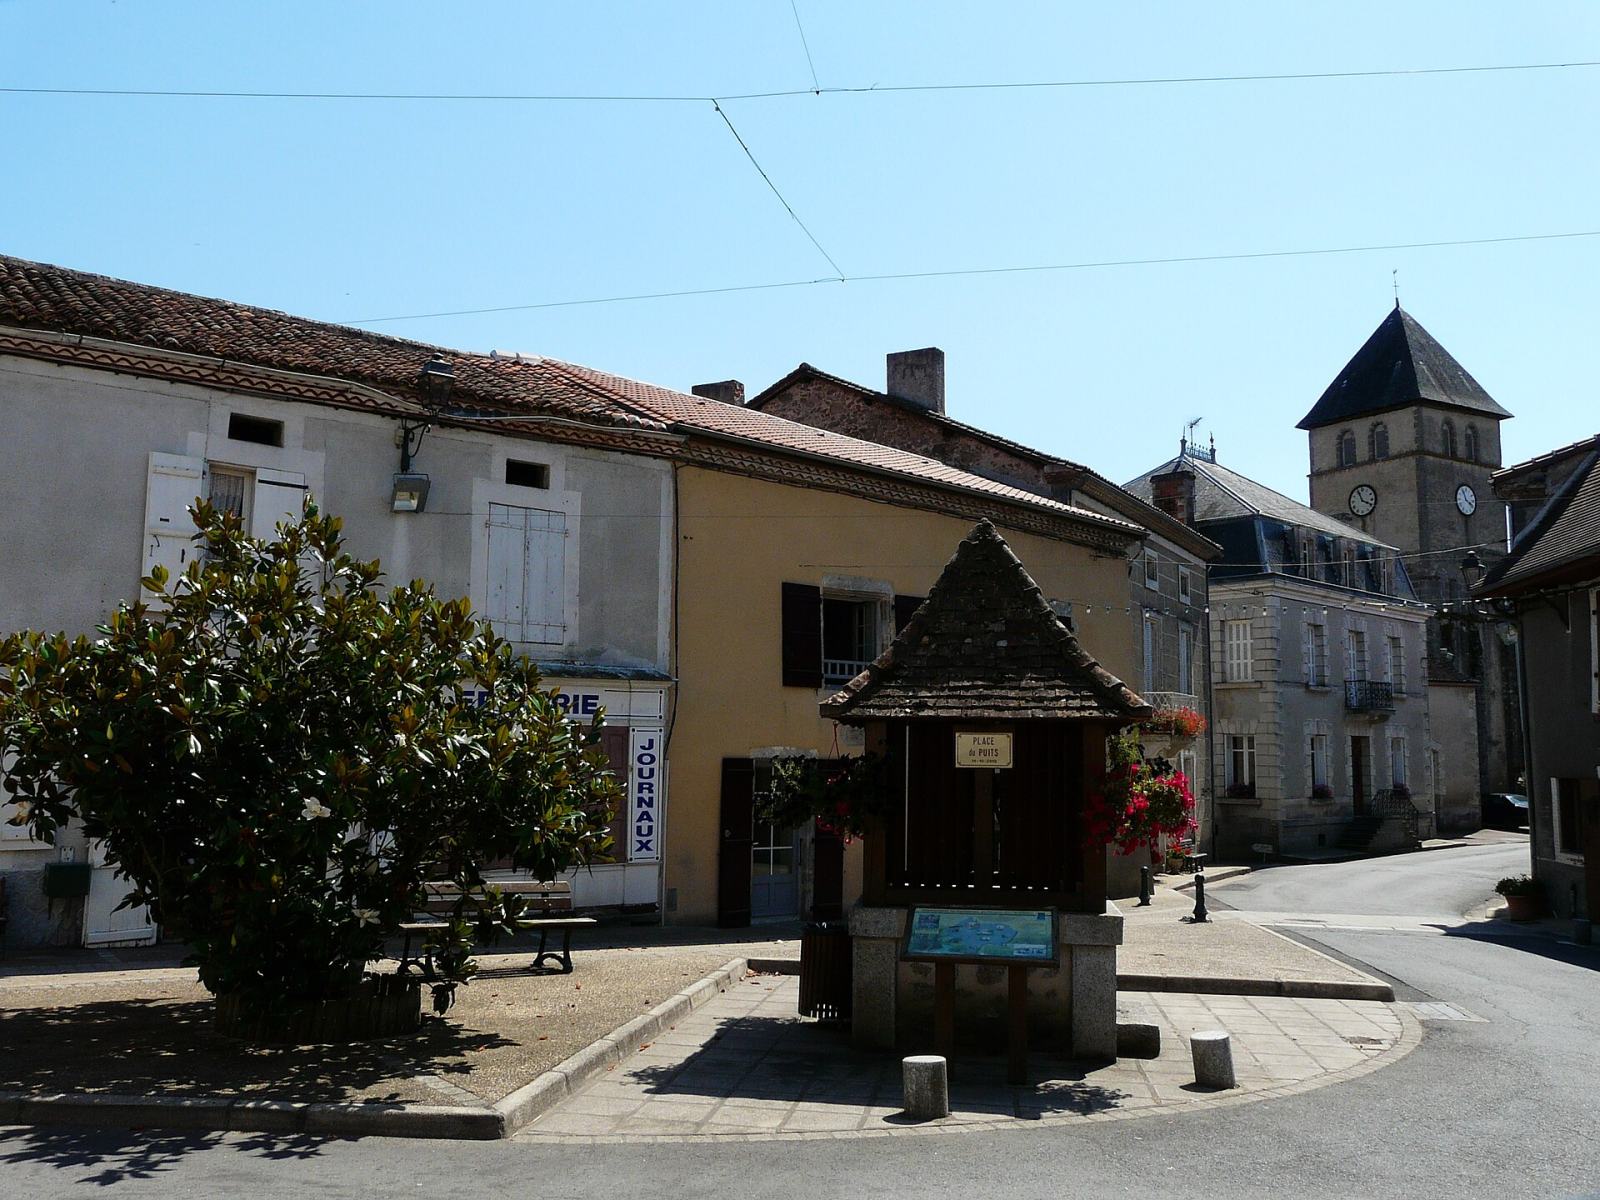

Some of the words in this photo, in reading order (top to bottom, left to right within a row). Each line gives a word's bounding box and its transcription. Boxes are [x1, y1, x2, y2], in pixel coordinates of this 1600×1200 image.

[972, 736, 995, 745] PLACE
[978, 748, 999, 757] PUITS
[635, 738, 656, 852] JOURNAUX
